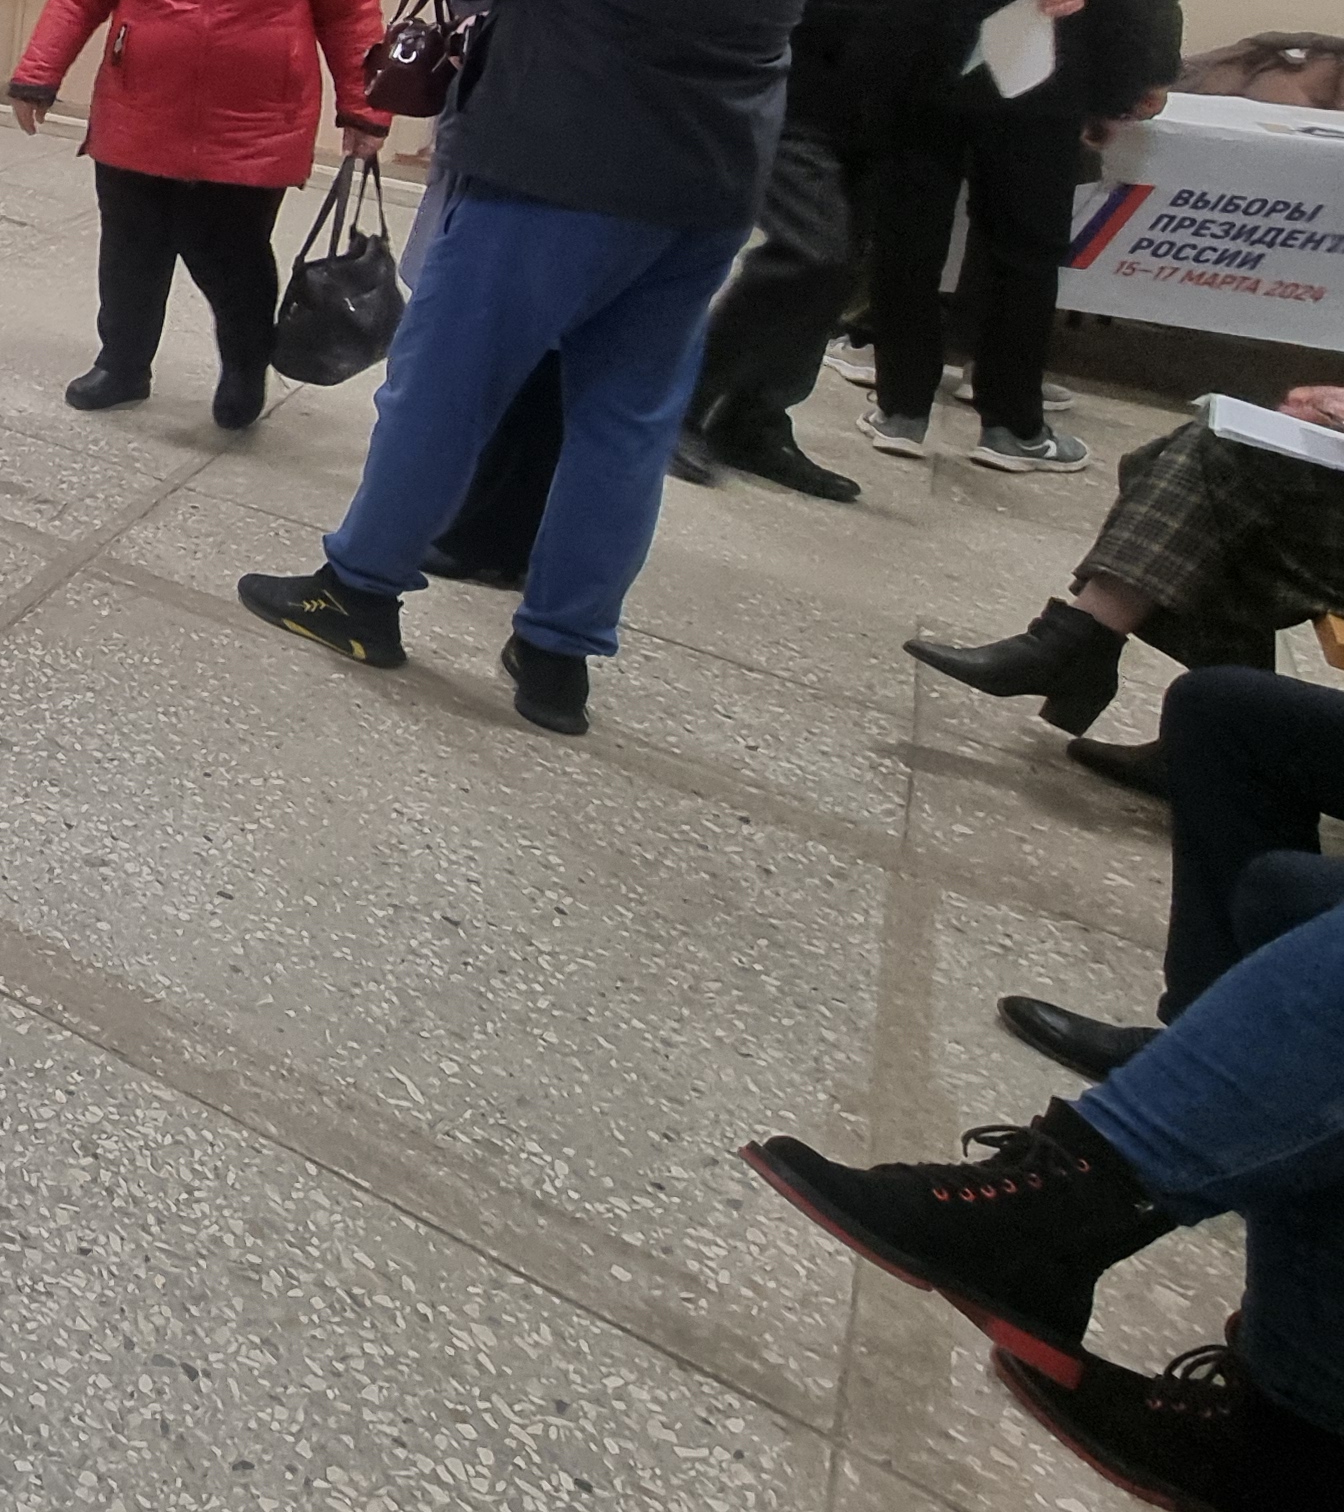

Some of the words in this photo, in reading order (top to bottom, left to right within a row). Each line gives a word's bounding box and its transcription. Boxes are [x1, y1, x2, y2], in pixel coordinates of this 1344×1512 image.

[1169, 189, 1324, 222] ВЫБОРЫ
[1148, 214, 1344, 254] ПРЕЗИДЕНТ
[1128, 238, 1266, 270] РОССИИ
[1180, 270, 1264, 294] МАРТА
